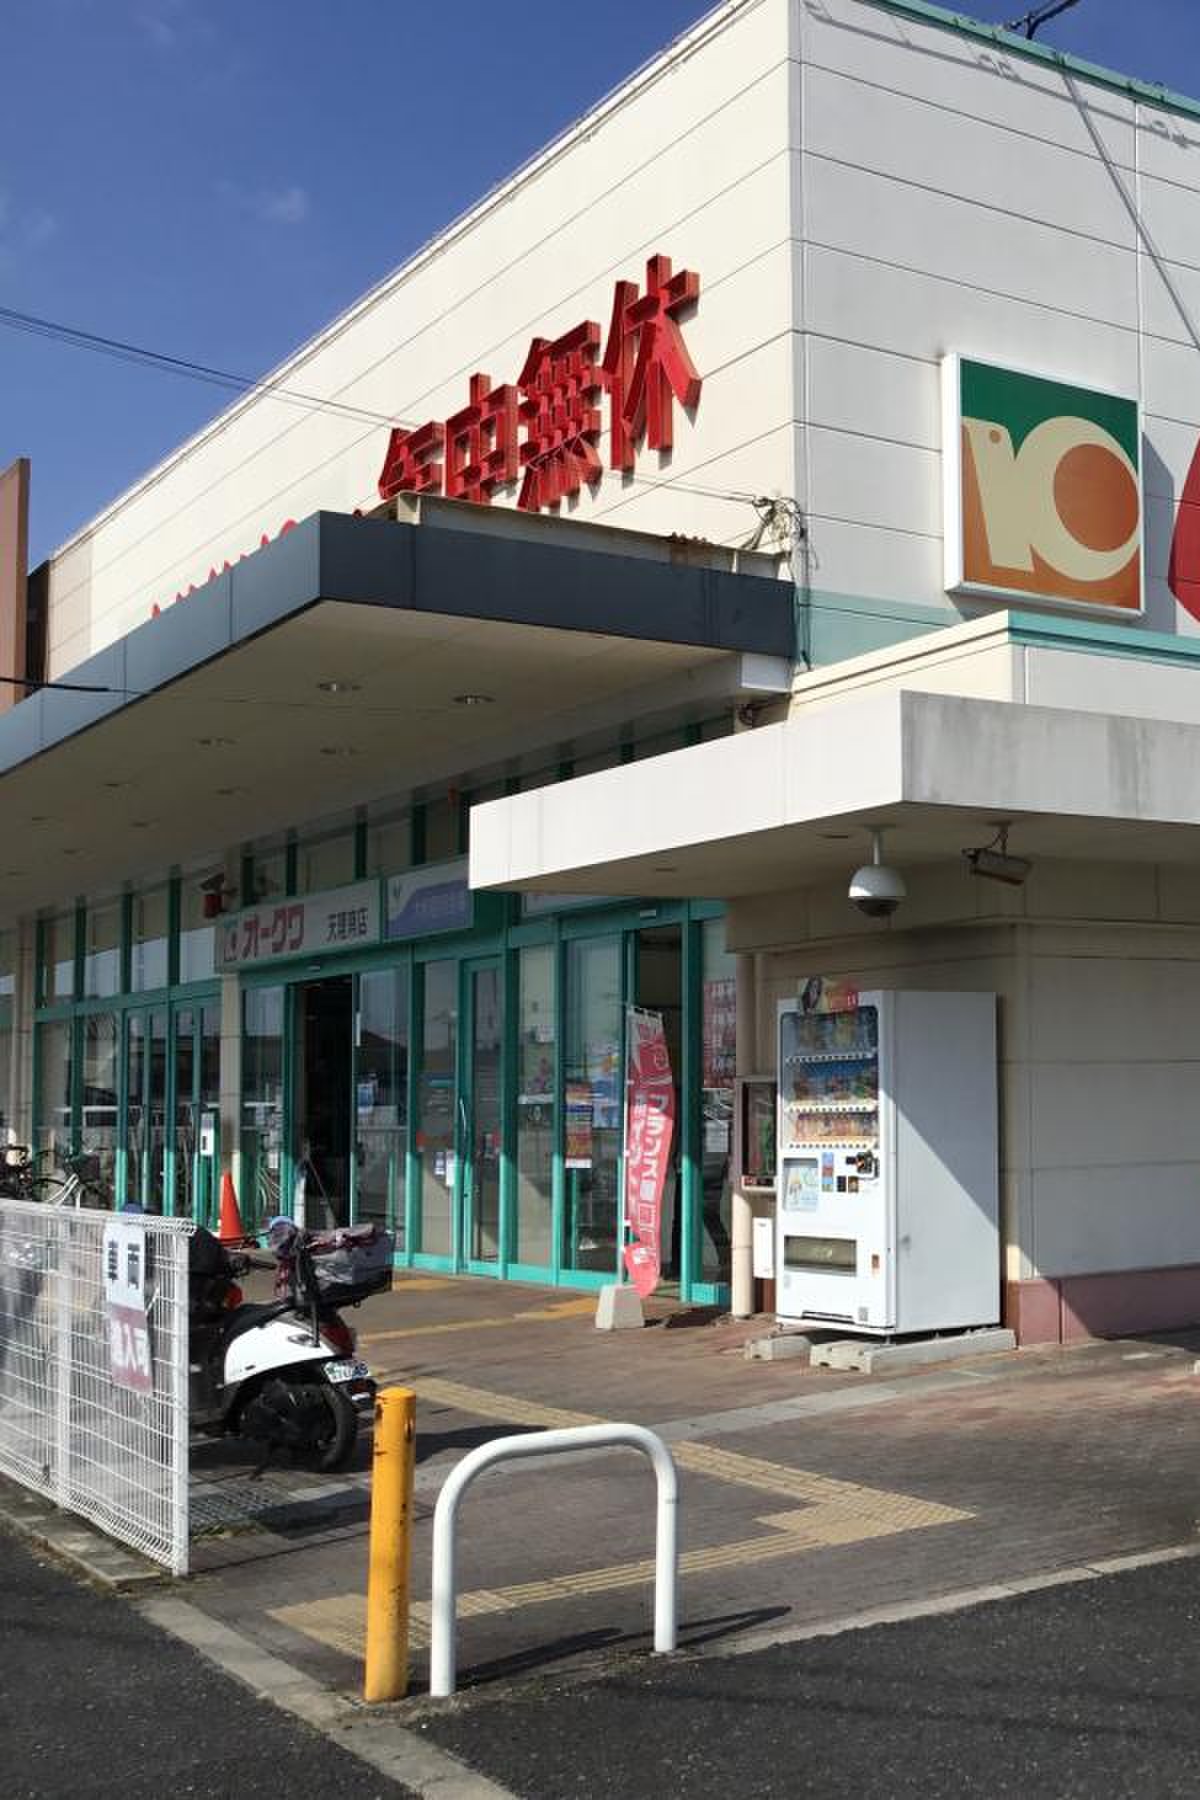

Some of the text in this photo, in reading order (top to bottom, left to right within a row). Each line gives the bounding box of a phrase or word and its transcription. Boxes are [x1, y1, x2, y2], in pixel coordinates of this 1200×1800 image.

[379, 254, 702, 514] 年中無休
[243, 904, 304, 960] オークワ
